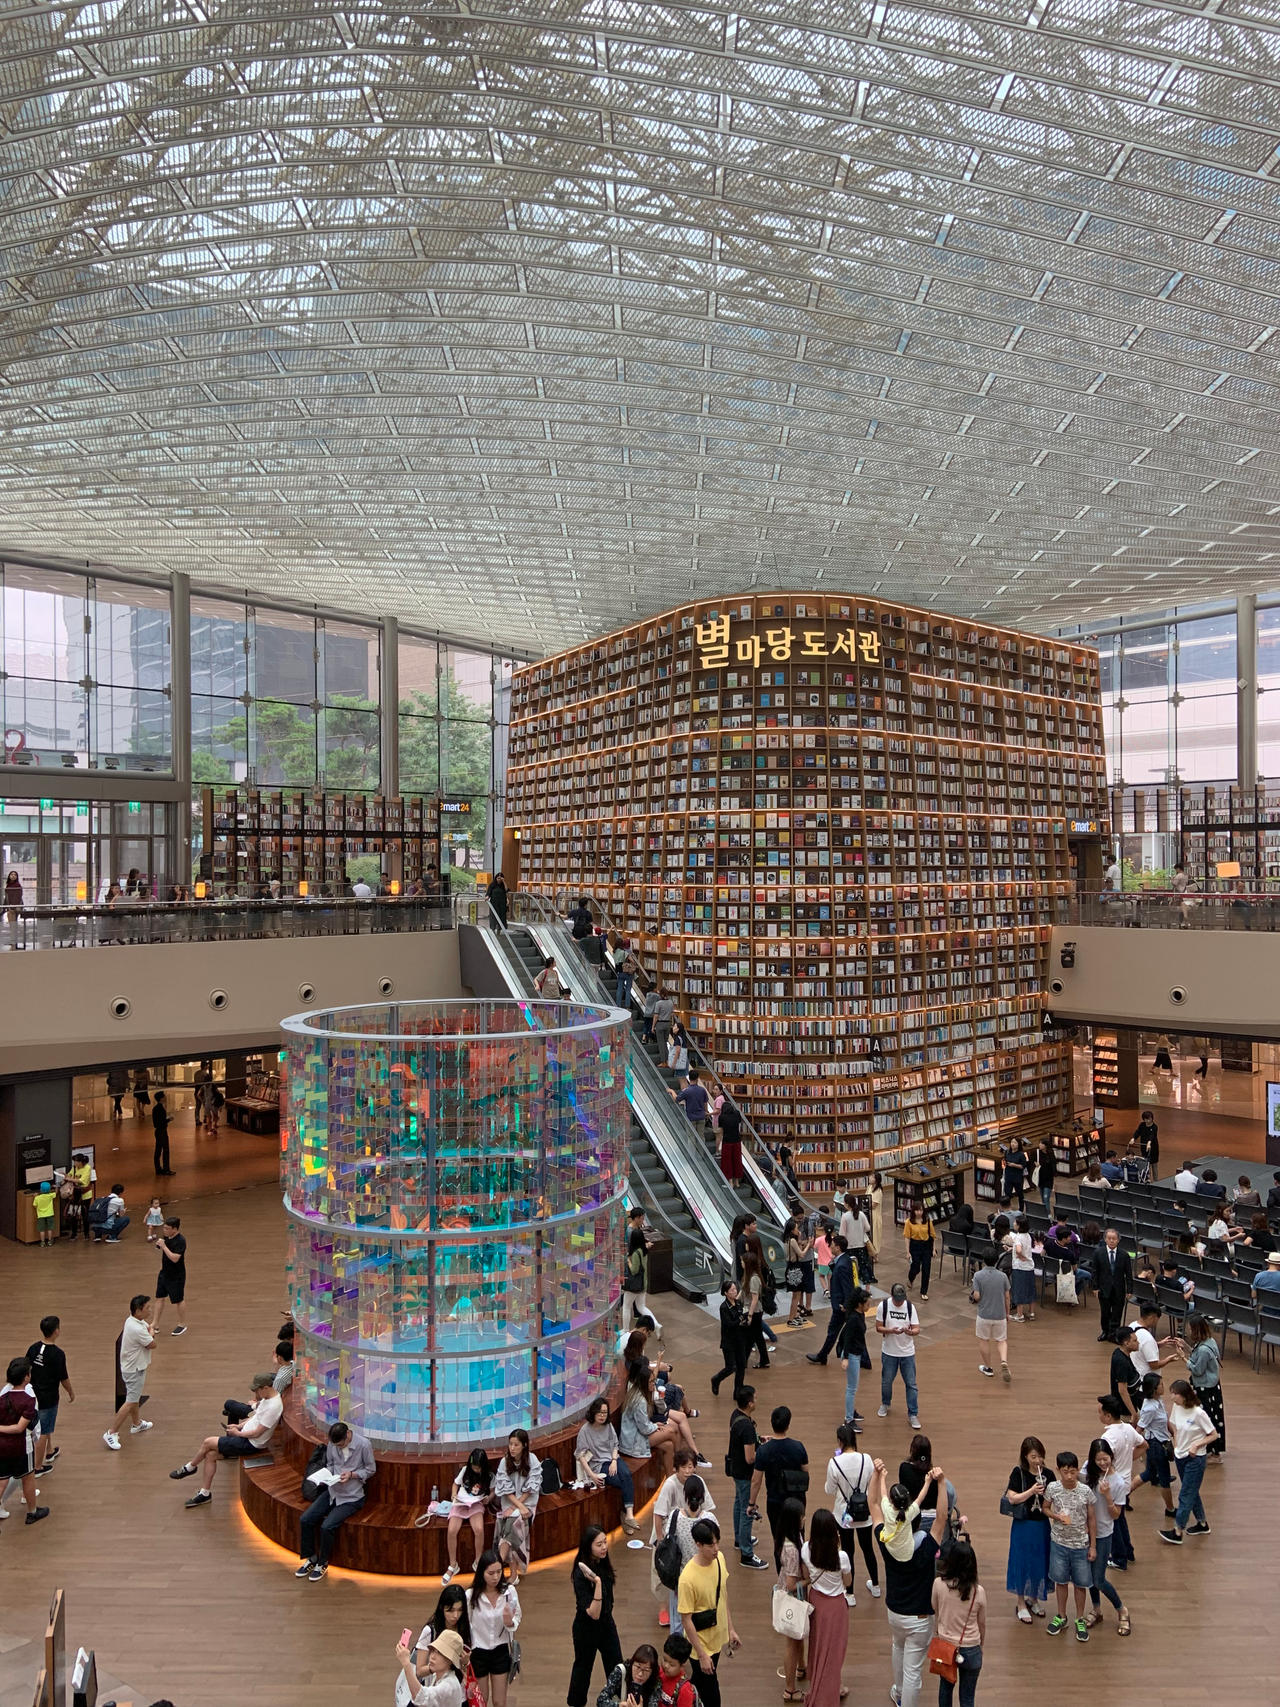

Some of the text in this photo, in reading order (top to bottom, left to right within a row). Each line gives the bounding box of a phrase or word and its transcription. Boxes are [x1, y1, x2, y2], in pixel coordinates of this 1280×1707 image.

[694, 614, 881, 669] 별마당 도서관
[1043, 1013, 1052, 1024] A
[873, 1039, 880, 1051] A
